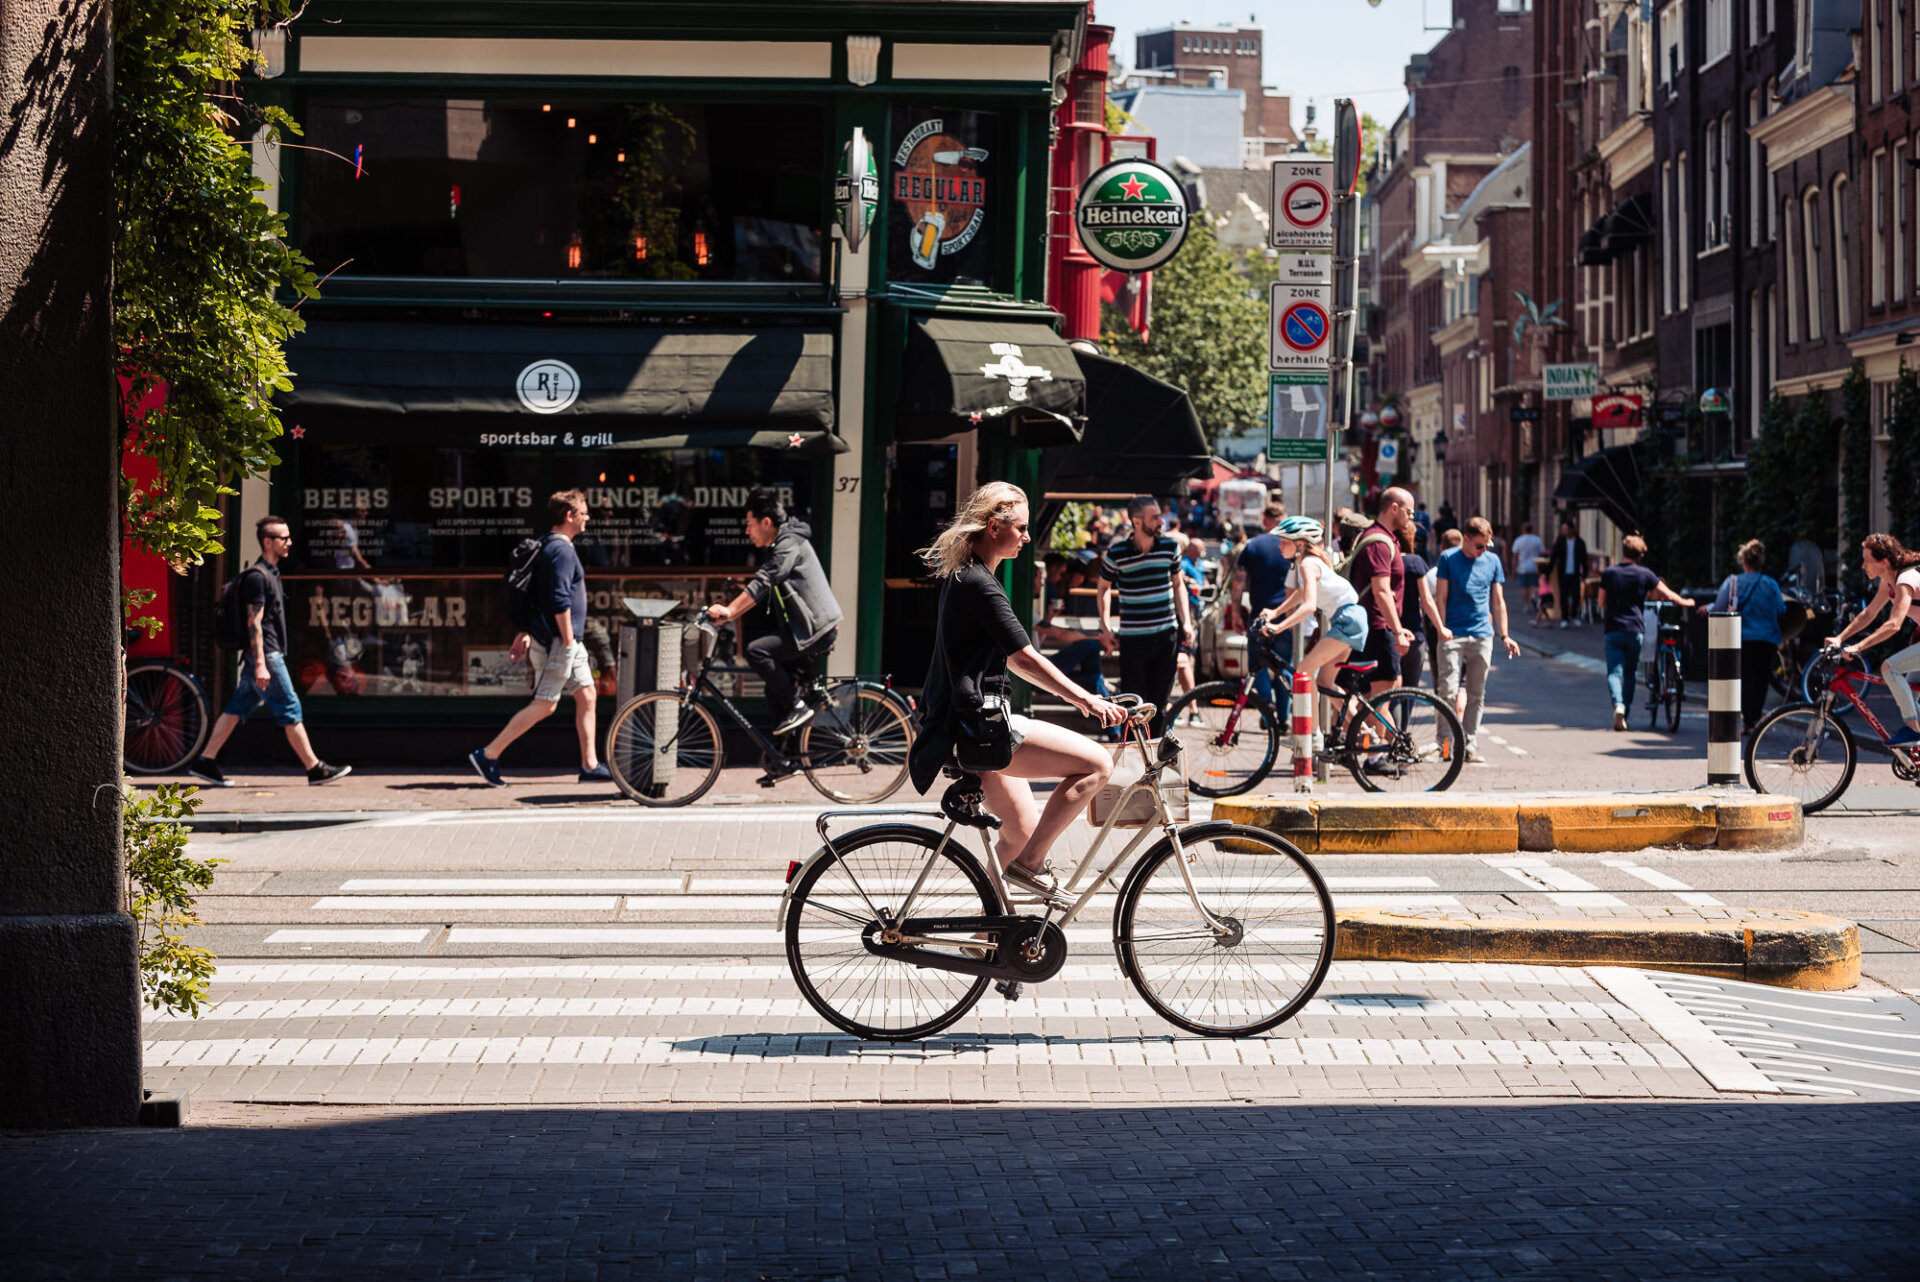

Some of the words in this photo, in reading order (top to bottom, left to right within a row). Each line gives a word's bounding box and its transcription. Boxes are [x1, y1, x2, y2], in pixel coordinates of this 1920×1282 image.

[897, 121, 942, 164] RESTAURANT
[1291, 167, 1322, 176] ZONE
[898, 175, 983, 204] REGULAR
[1086, 207, 1180, 225] Heineken
[943, 210, 984, 254] SPORTSBAR
[1289, 269, 1323, 277] Terrassen
[1290, 288, 1321, 298] ZONE
[1546, 367, 1580, 384] INDIAN
[480, 432, 557, 447] sportsbar
[563, 432, 574, 445] &
[581, 432, 614, 447] grill
[835, 476, 860, 493] 37
[304, 488, 389, 509] BEERS
[429, 487, 533, 508] SPORTS
[586, 487, 660, 508] UNCH
[694, 487, 795, 508] DINNR
[308, 596, 467, 627] REGULAR
